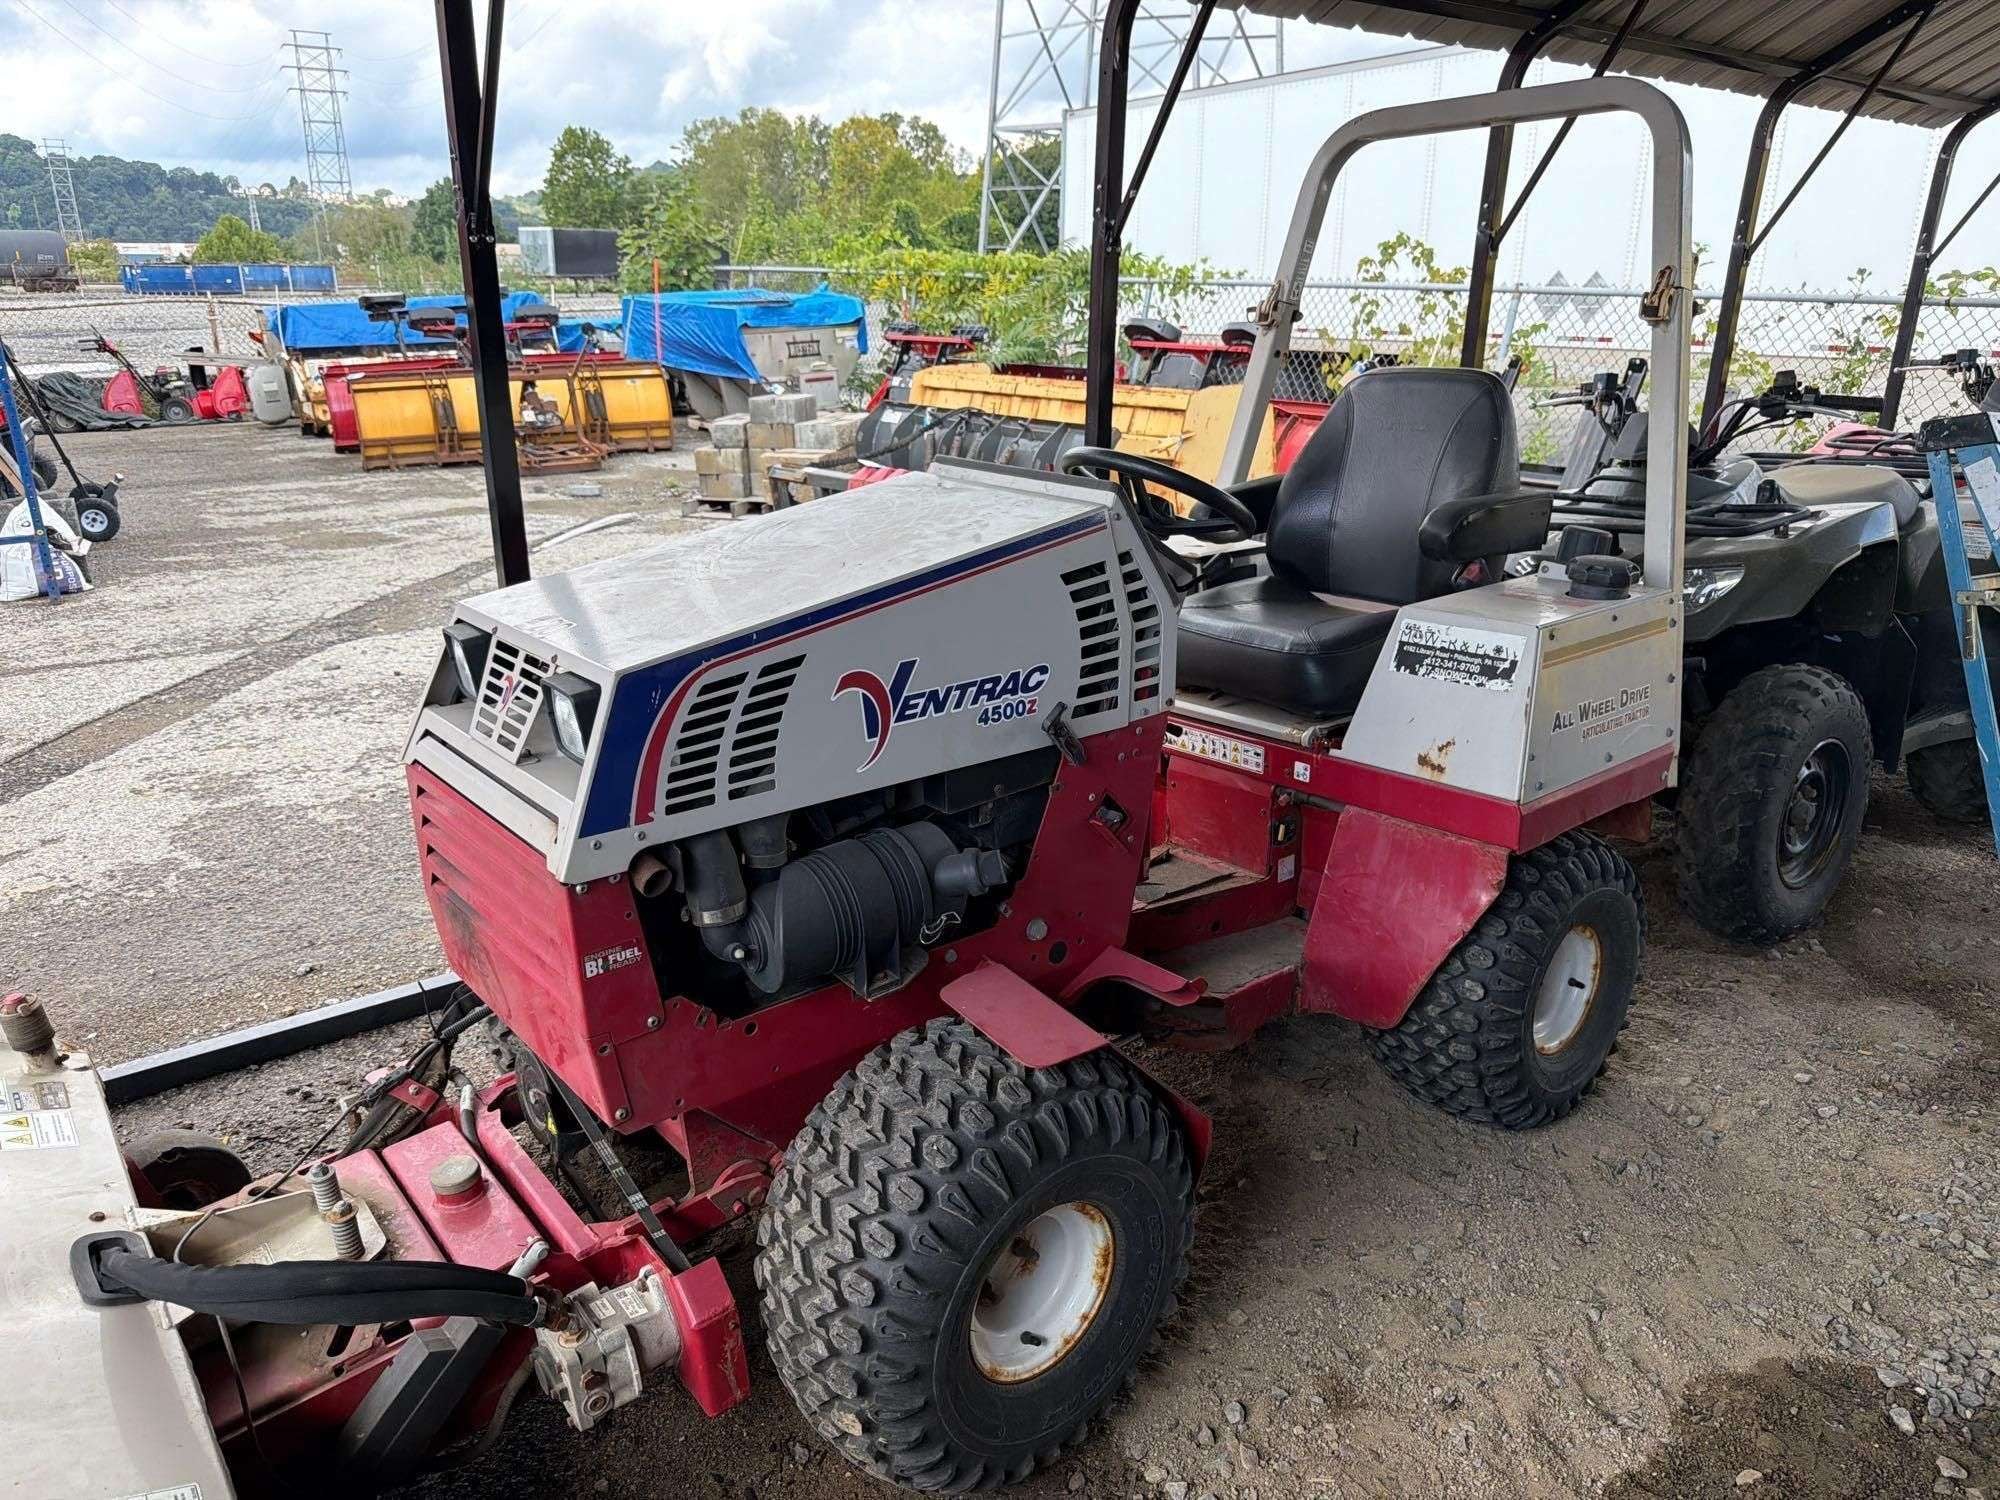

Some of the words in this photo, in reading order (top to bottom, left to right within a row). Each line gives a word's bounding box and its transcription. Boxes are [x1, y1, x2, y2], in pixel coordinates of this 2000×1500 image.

[831, 657, 1050, 772] VENTRAC
[976, 698, 1037, 726] 4500Z
[608, 947, 642, 964] FUEL
[609, 956, 641, 970] READY
